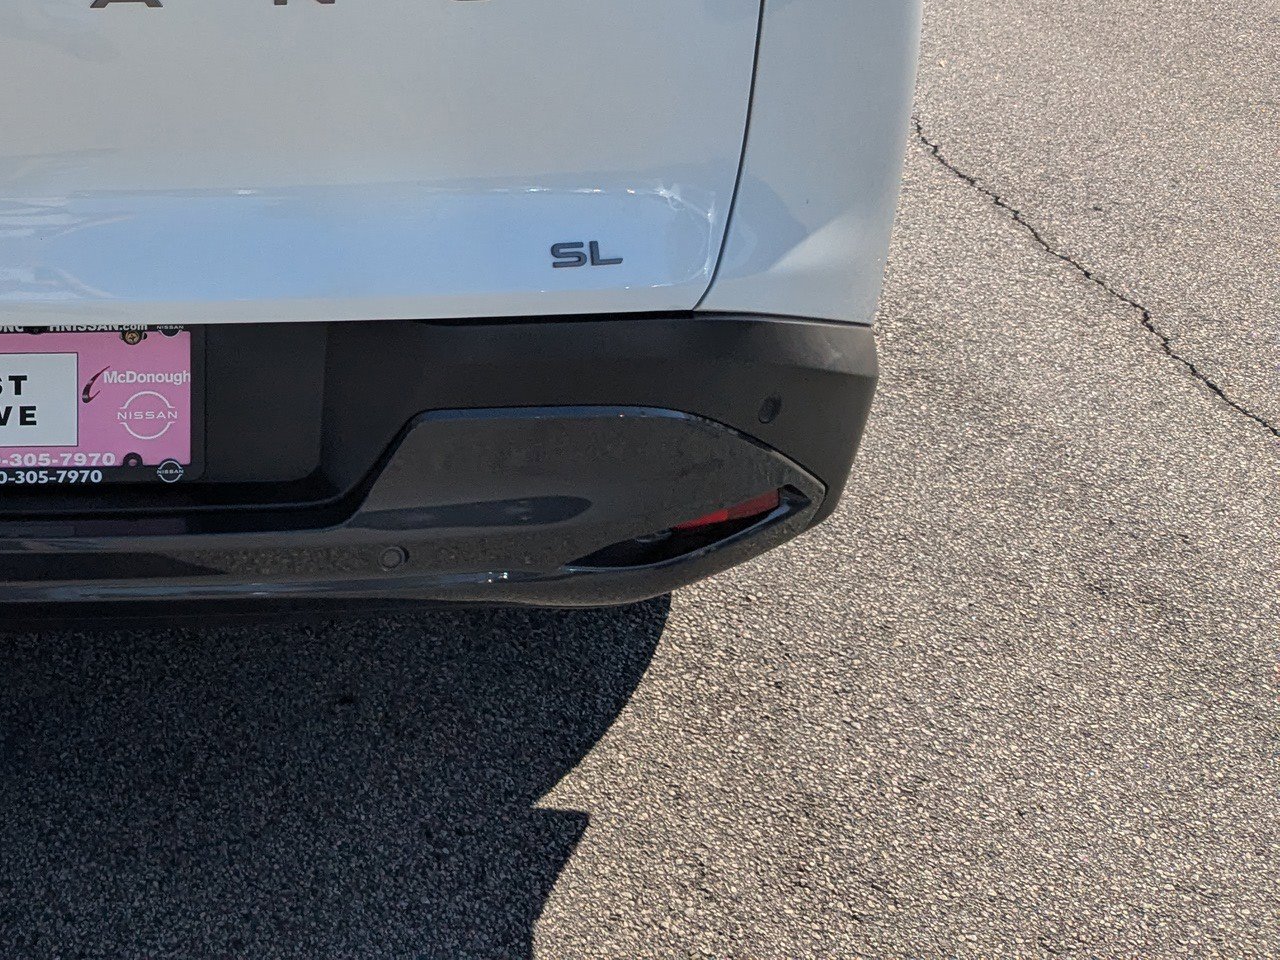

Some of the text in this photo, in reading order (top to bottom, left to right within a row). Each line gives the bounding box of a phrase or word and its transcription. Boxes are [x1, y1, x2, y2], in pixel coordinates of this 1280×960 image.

[550, 240, 624, 268] SL
[103, 370, 190, 386] McDonough
[117, 411, 178, 420] NISSAN
